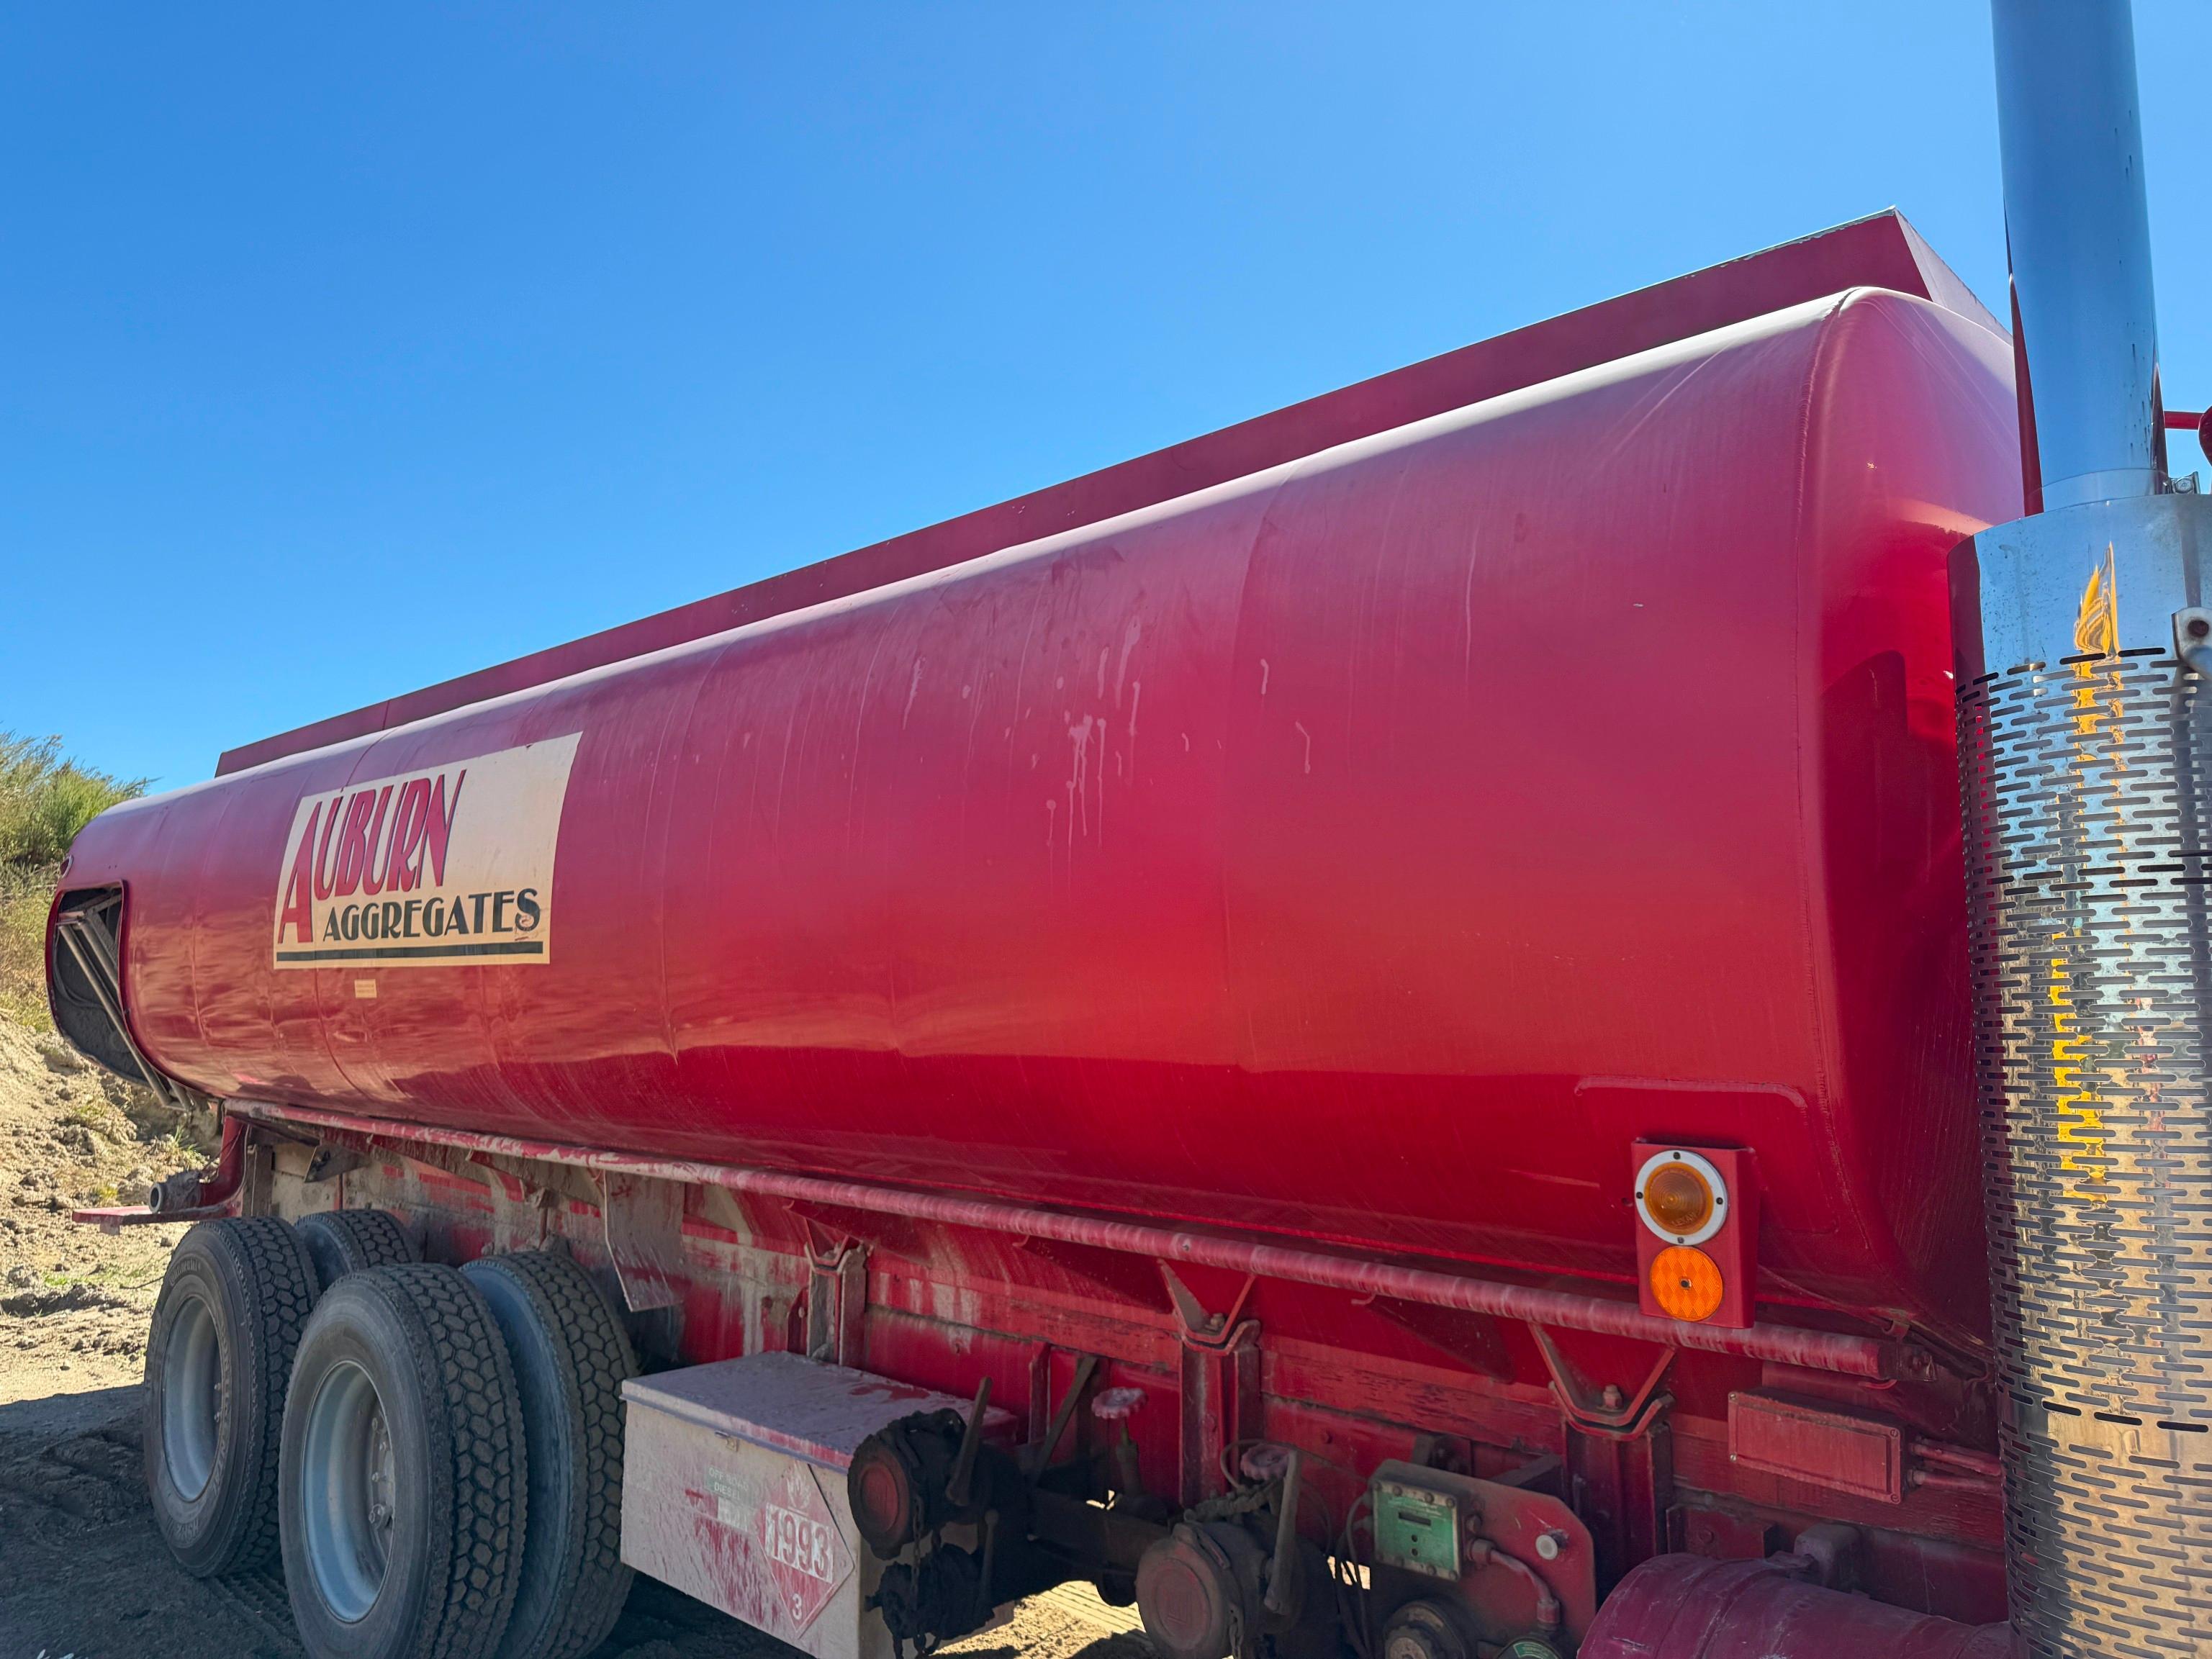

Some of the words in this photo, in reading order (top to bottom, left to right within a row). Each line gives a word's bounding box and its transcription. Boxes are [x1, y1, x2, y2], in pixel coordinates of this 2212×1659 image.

[278, 769, 467, 944] AUBURN
[323, 888, 541, 941] AGGREGATES
[708, 1467, 724, 1481] OFF
[714, 1481, 740, 1500] DIESEL
[771, 1511, 829, 1578] 1993
[792, 1593, 803, 1620] 3
